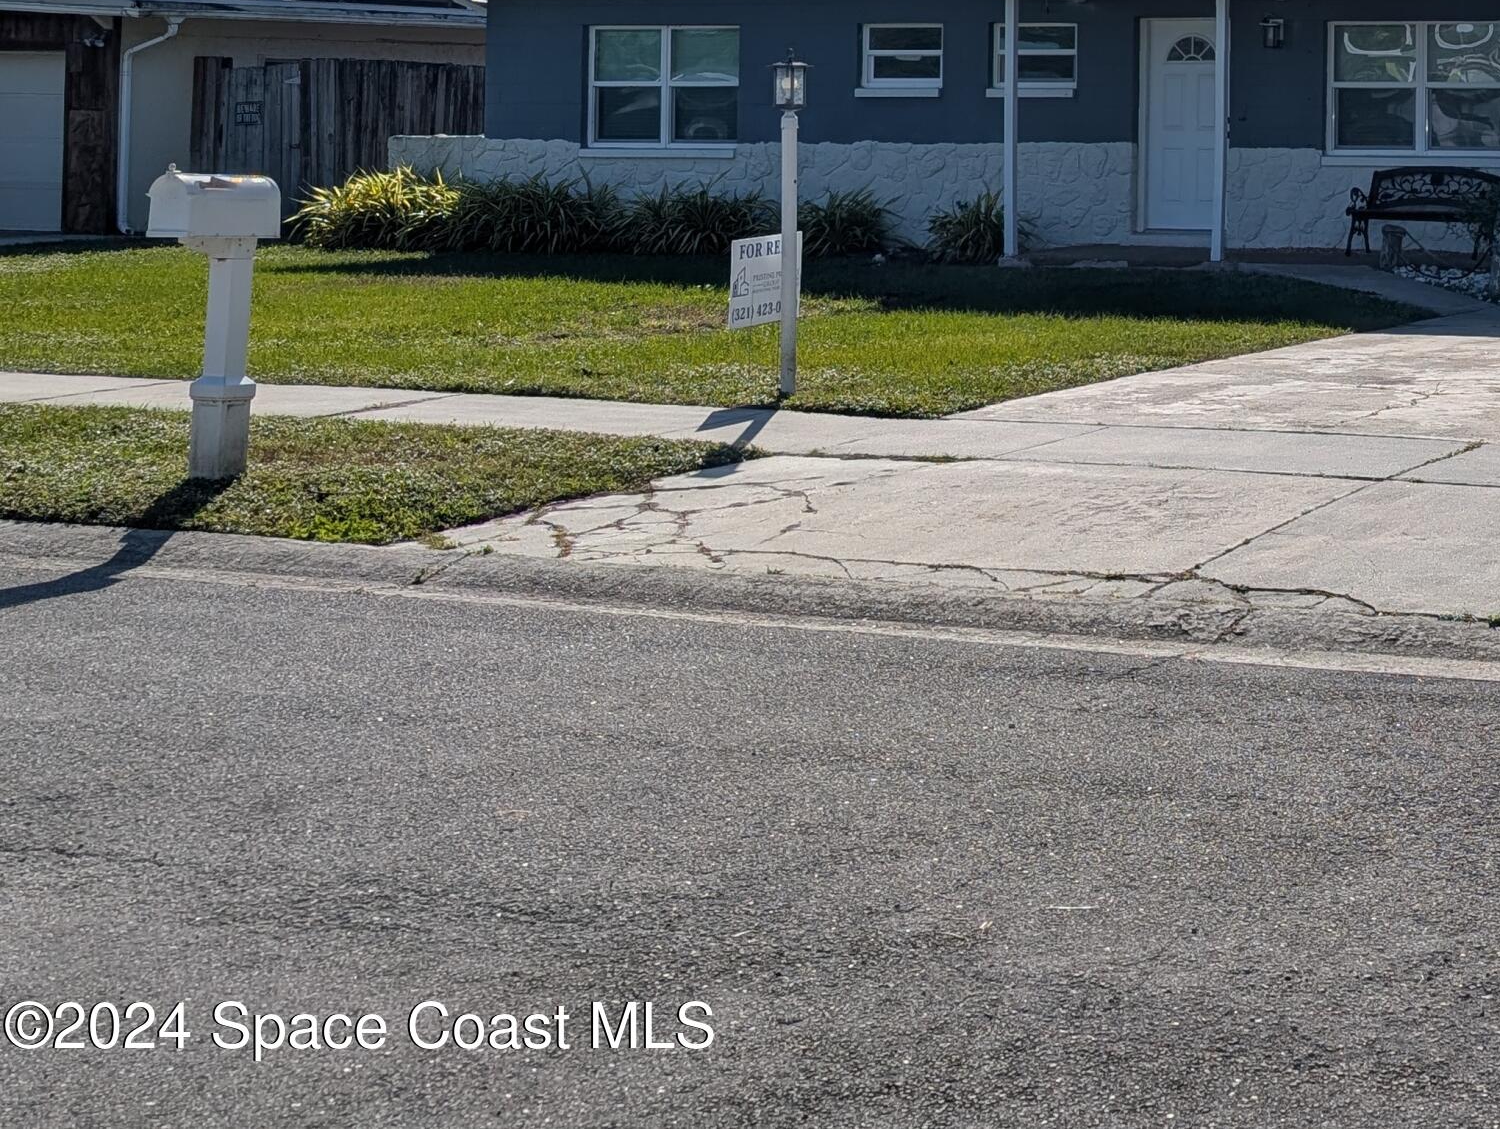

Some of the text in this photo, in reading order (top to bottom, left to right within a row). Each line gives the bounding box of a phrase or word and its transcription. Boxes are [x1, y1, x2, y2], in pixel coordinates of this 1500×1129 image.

[739, 239, 781, 260] FOR RE
[731, 301, 782, 324] (321) 423-0
